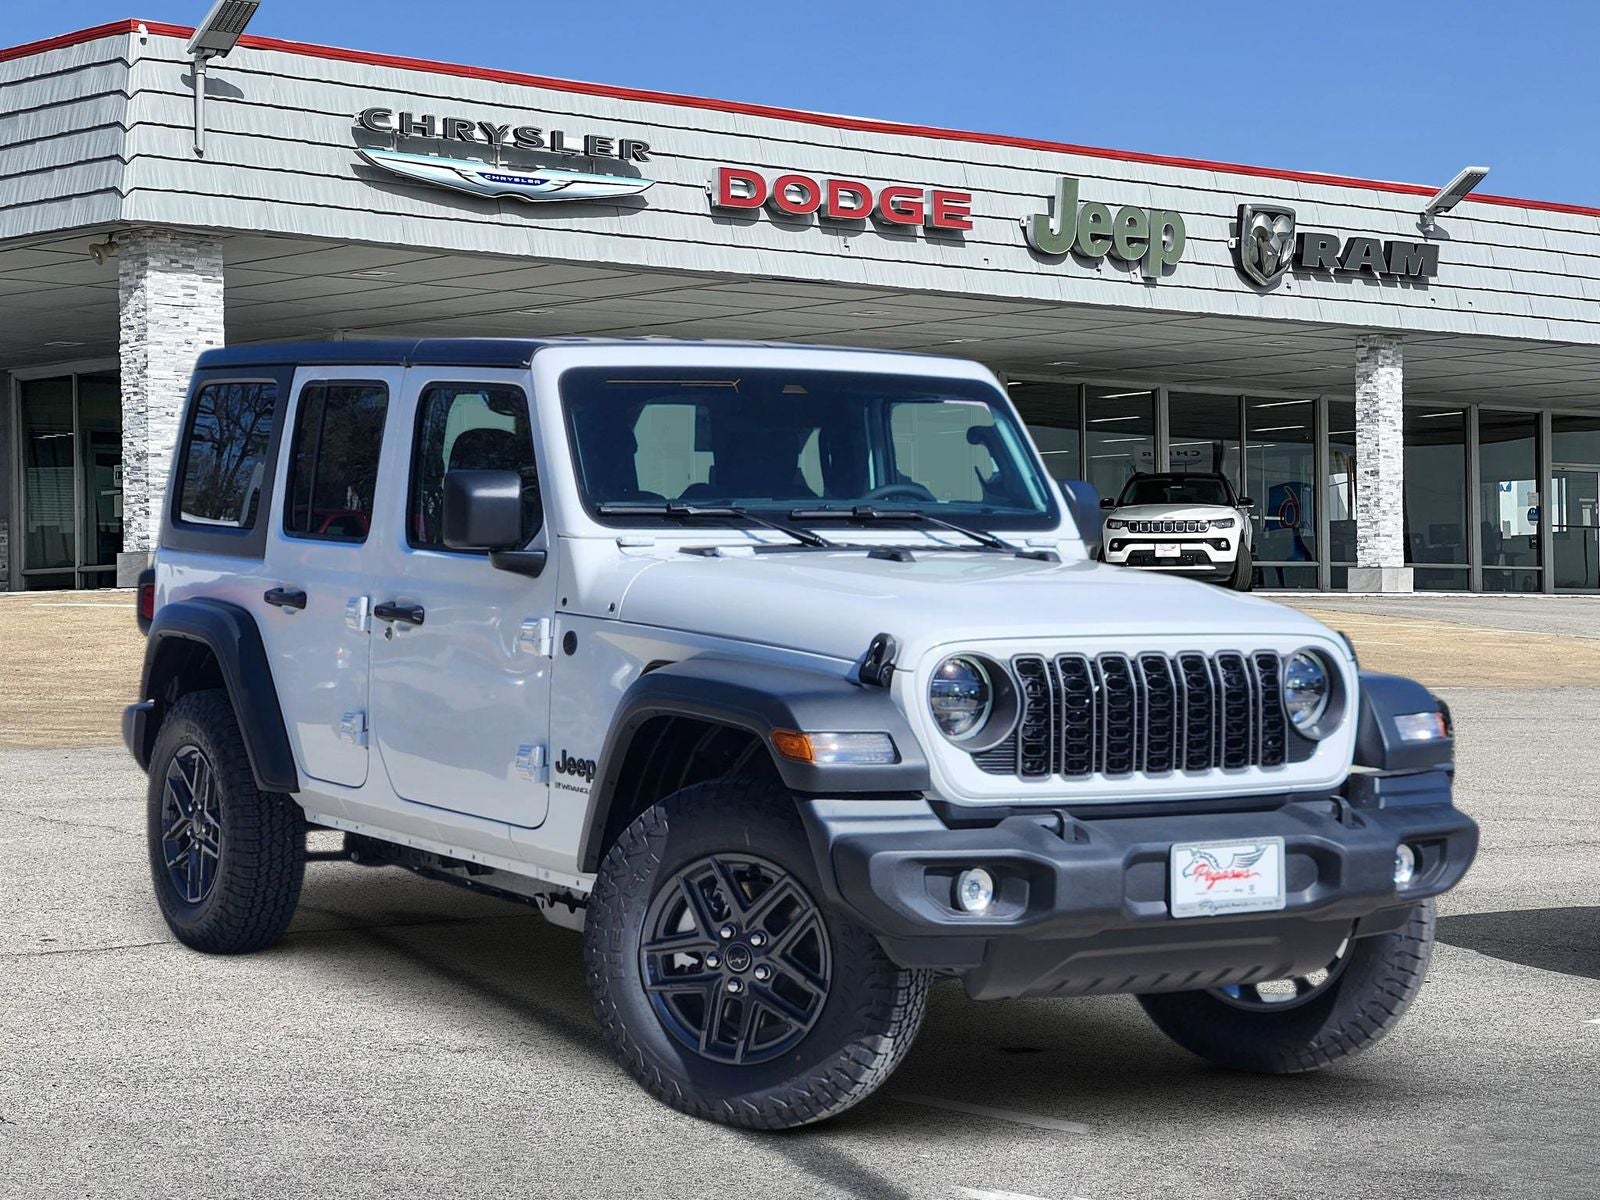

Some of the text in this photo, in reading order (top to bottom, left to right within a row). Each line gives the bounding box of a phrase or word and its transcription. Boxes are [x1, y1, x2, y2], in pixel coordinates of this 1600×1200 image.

[358, 107, 652, 162] CHRYSLER
[484, 174, 541, 185] CHRYSLER
[712, 167, 974, 231] DODGE
[1027, 177, 1187, 279] Jeep
[1296, 231, 1440, 278] RAM
[555, 749, 597, 784] Jeep
[561, 782, 592, 795] WRANGL
